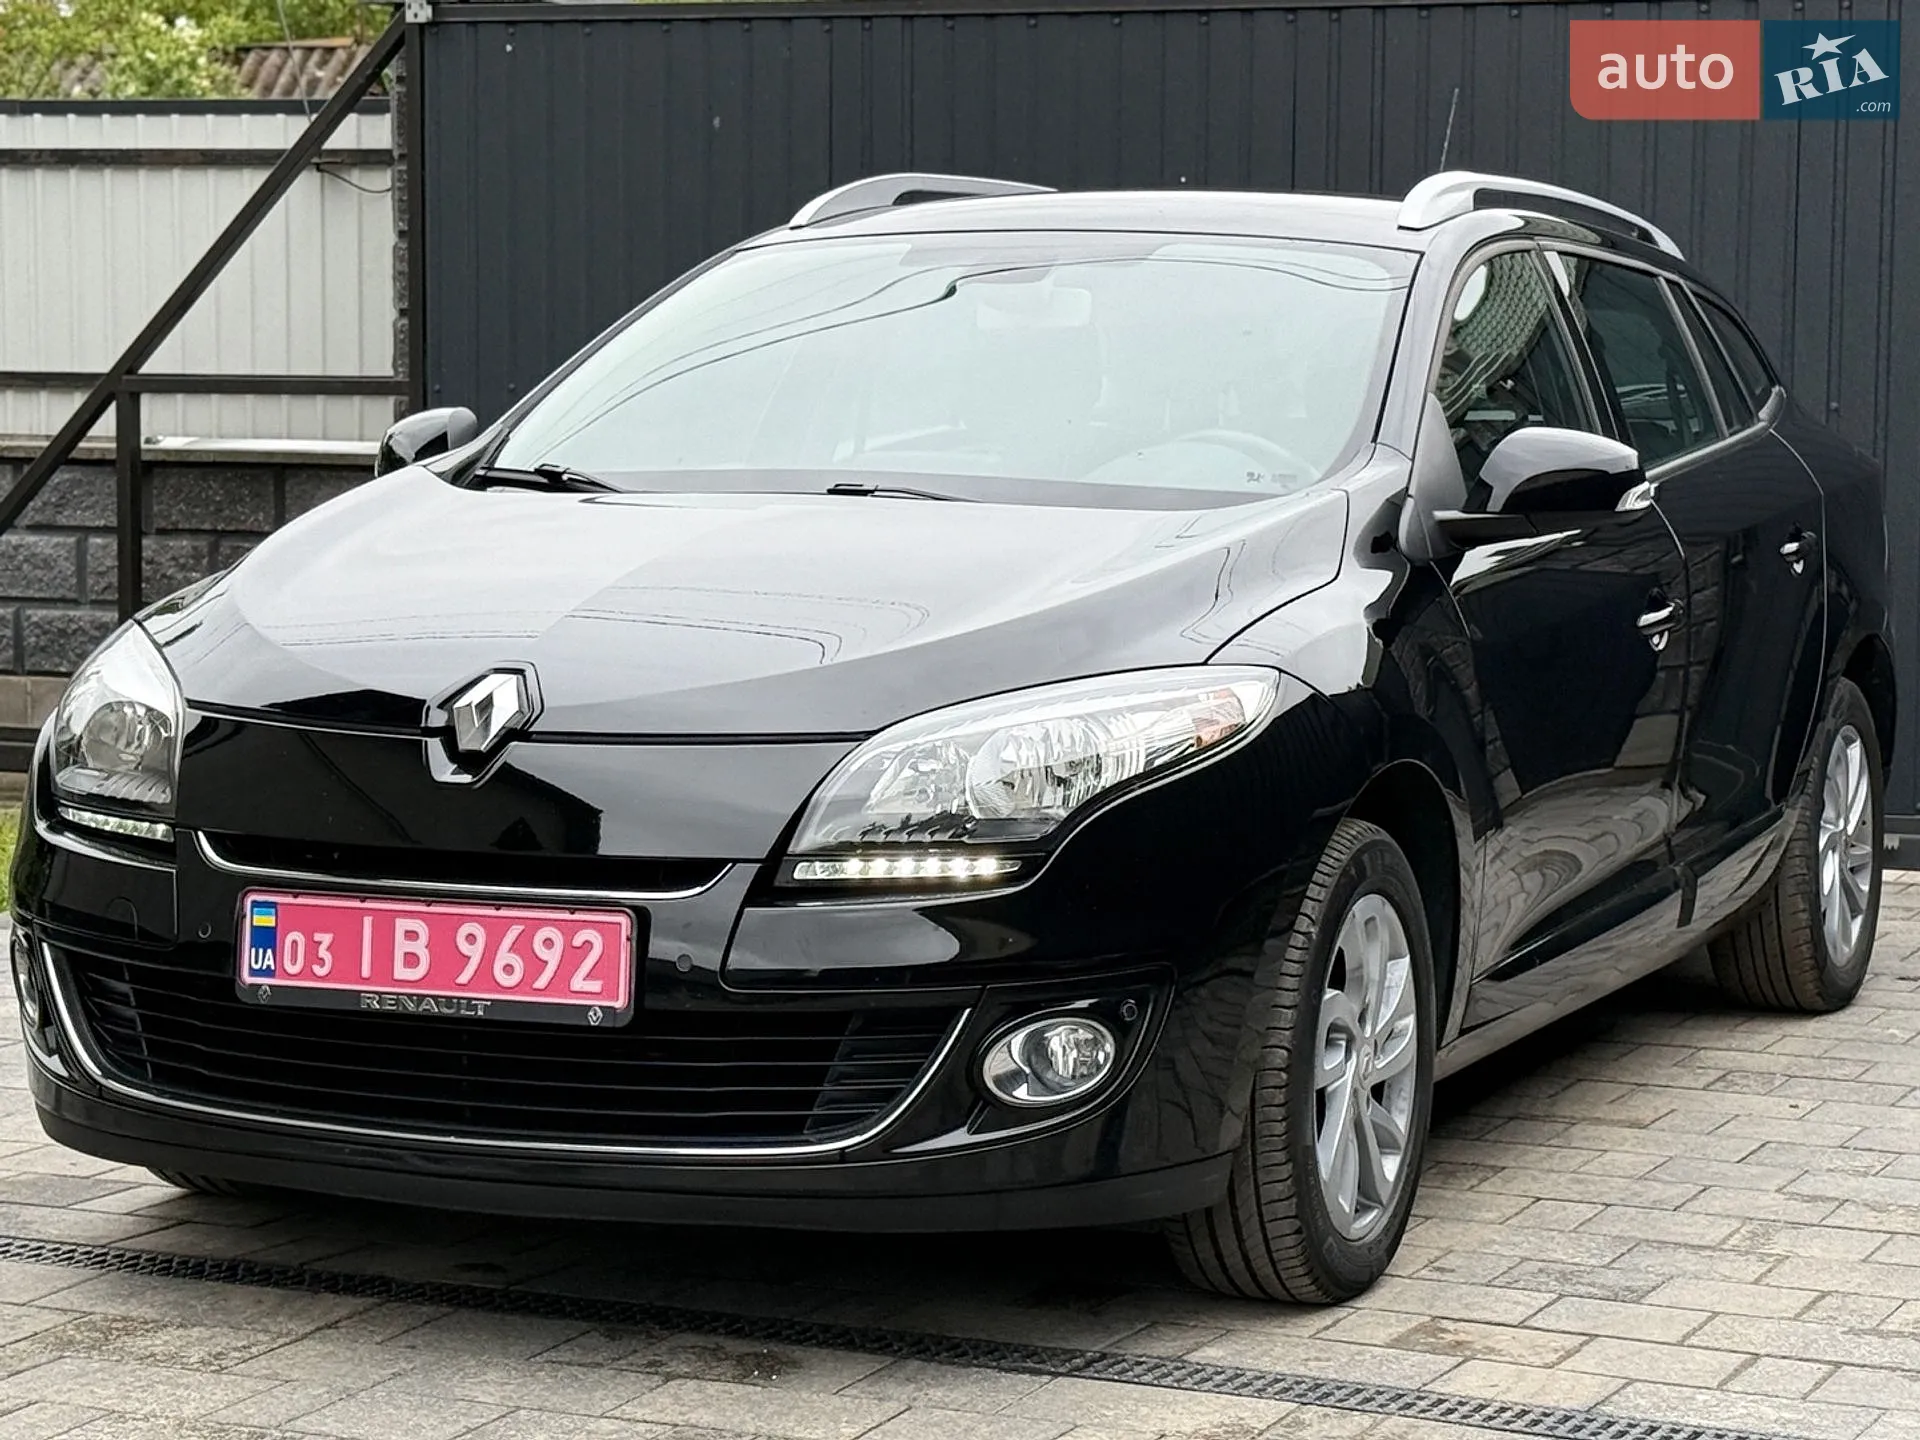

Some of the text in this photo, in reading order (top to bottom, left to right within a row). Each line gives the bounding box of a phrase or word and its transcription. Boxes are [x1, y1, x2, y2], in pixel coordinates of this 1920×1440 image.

[250, 947, 275, 970] UA
[283, 931, 334, 978] 03
[454, 921, 604, 994] 9692
[360, 993, 491, 1017] RENAULT
